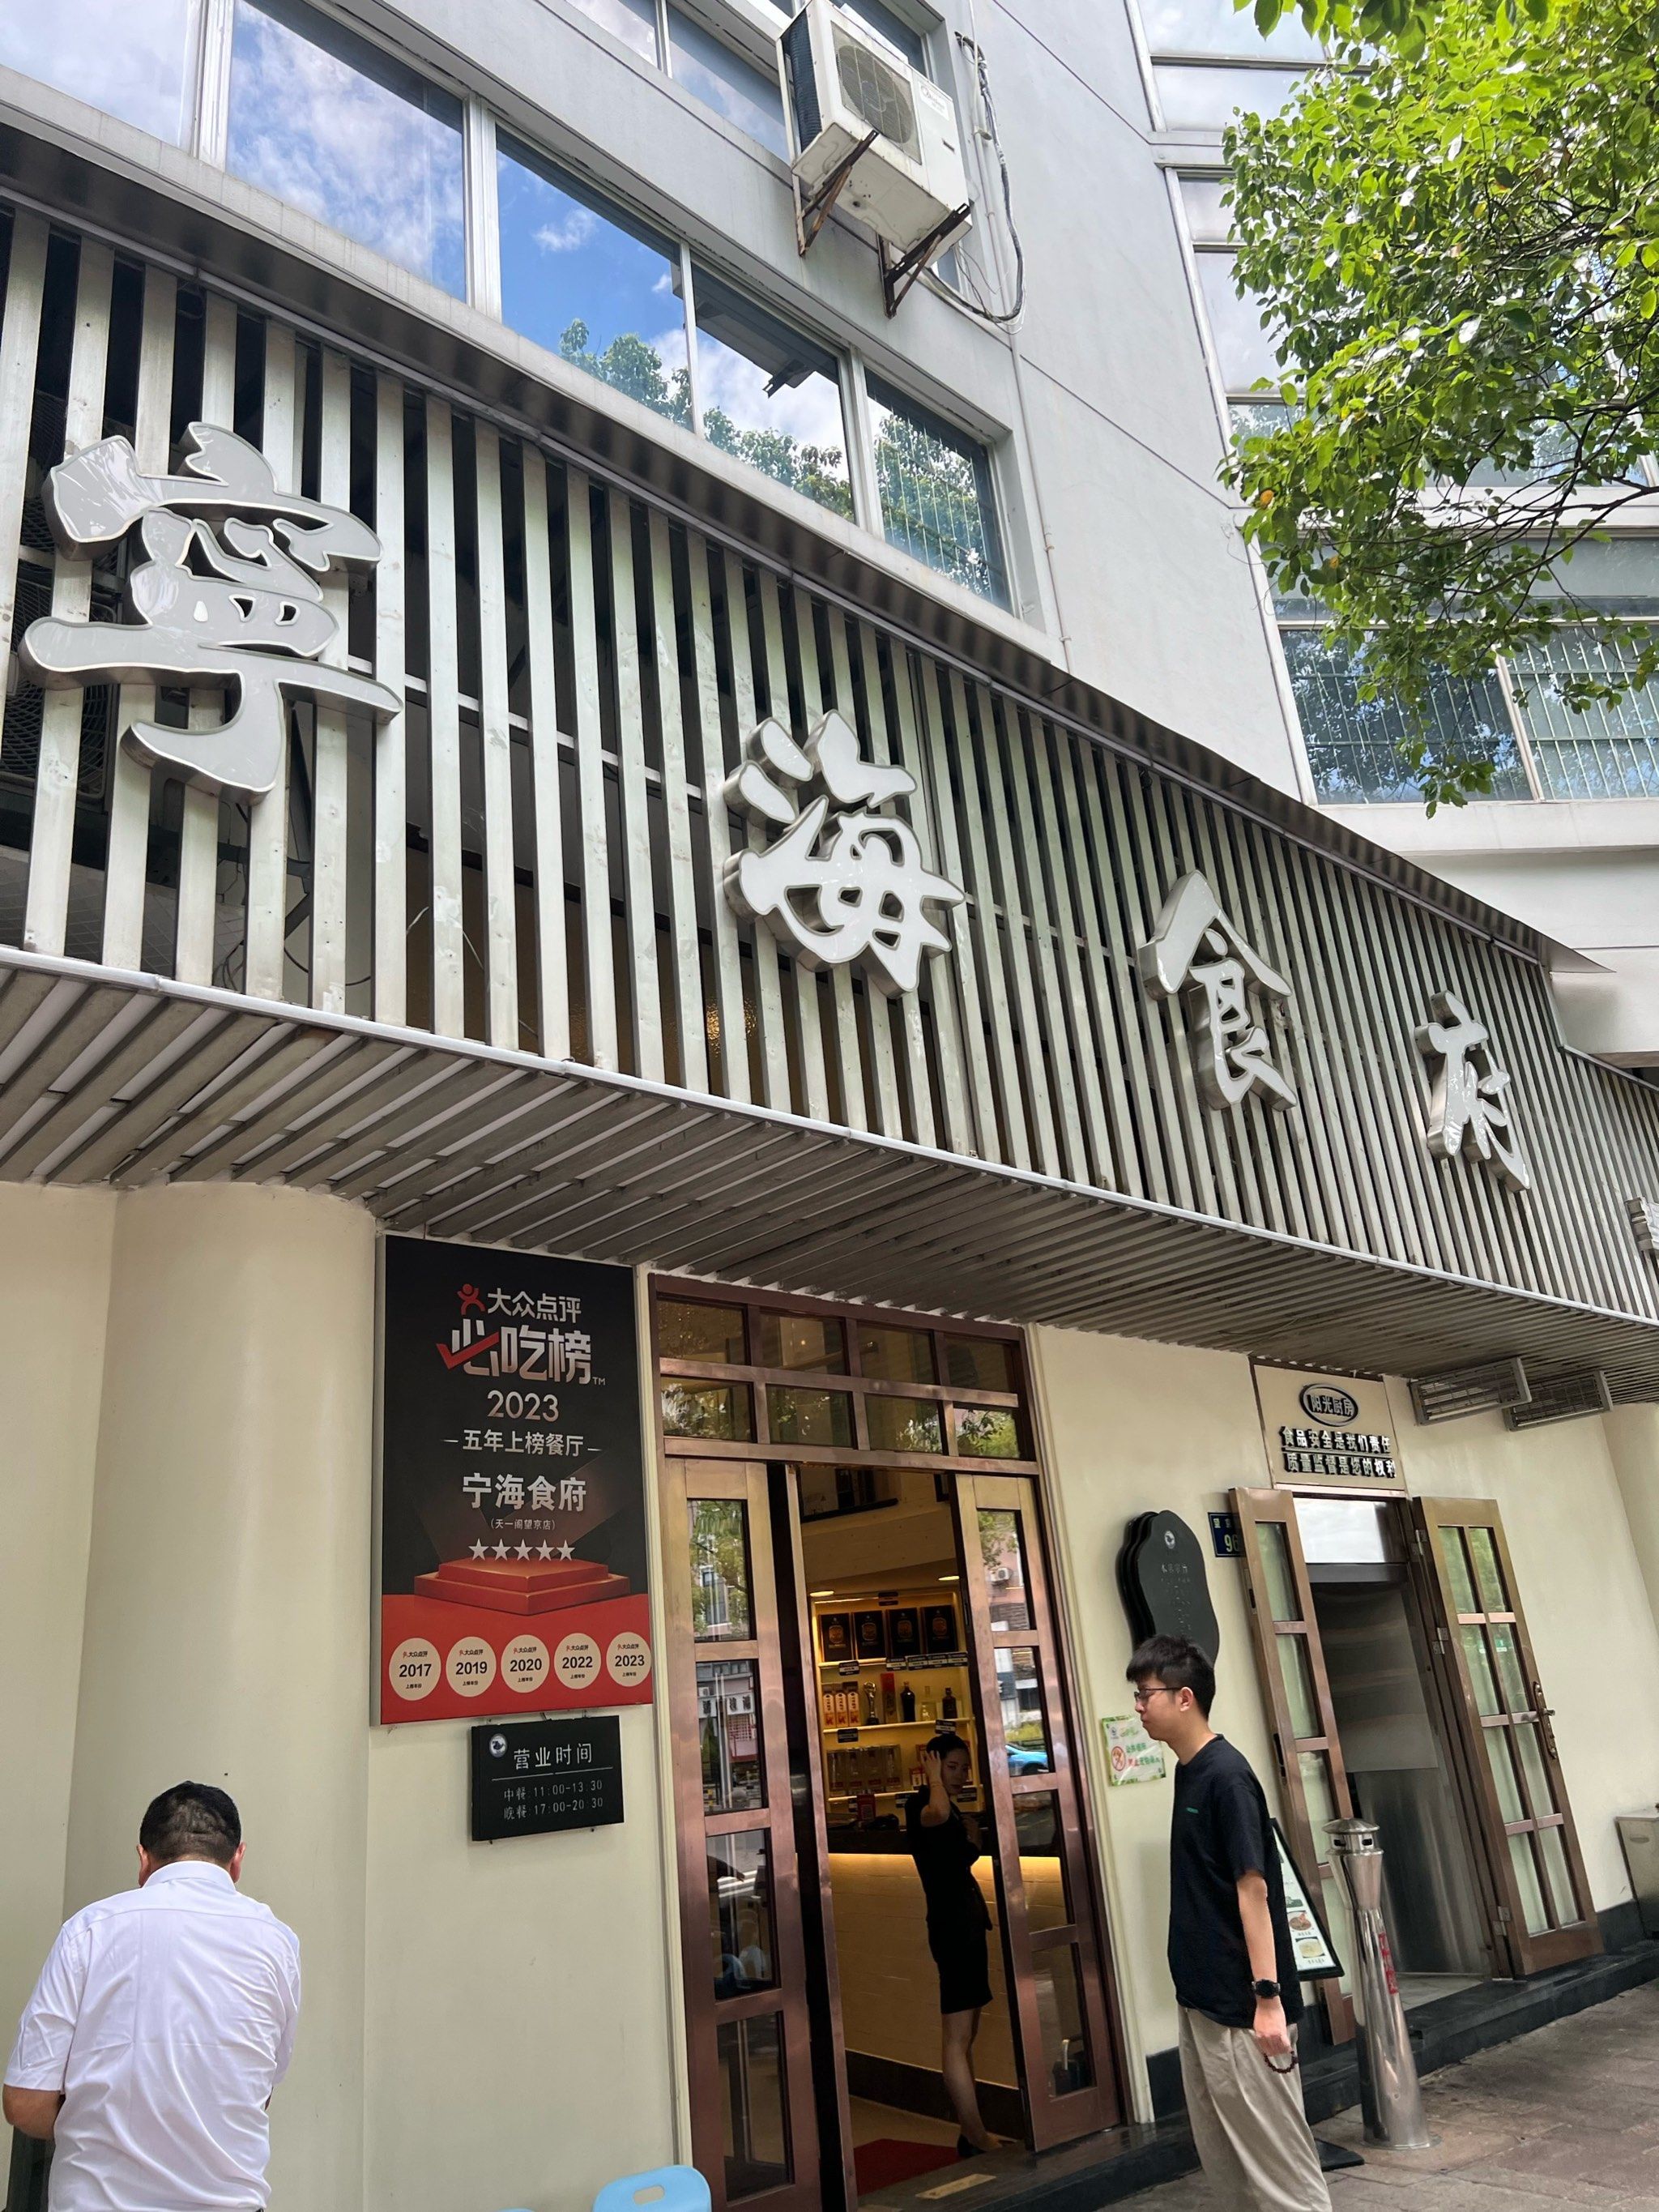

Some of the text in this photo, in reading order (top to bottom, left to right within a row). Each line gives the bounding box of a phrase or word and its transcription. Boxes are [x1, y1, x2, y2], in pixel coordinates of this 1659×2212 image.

[488, 1287, 582, 1324] 大众点评
[437, 1318, 591, 1385] 必吃榜
[487, 1390, 560, 1423] 2023
[1310, 1394, 1354, 1416] 阳光厨房
[463, 1428, 584, 1457] 五年上榜餐厅
[1282, 1426, 1391, 1453] 食品安全是我们责任
[463, 1472, 586, 1512] 宁海食府
[399, 1663, 432, 1678] 2017
[455, 1661, 488, 1675] 2019
[510, 1658, 543, 1672] 2020
[562, 1655, 593, 1669] 2022
[615, 1654, 645, 1668] 2023
[514, 1743, 593, 1770] 营业时间
